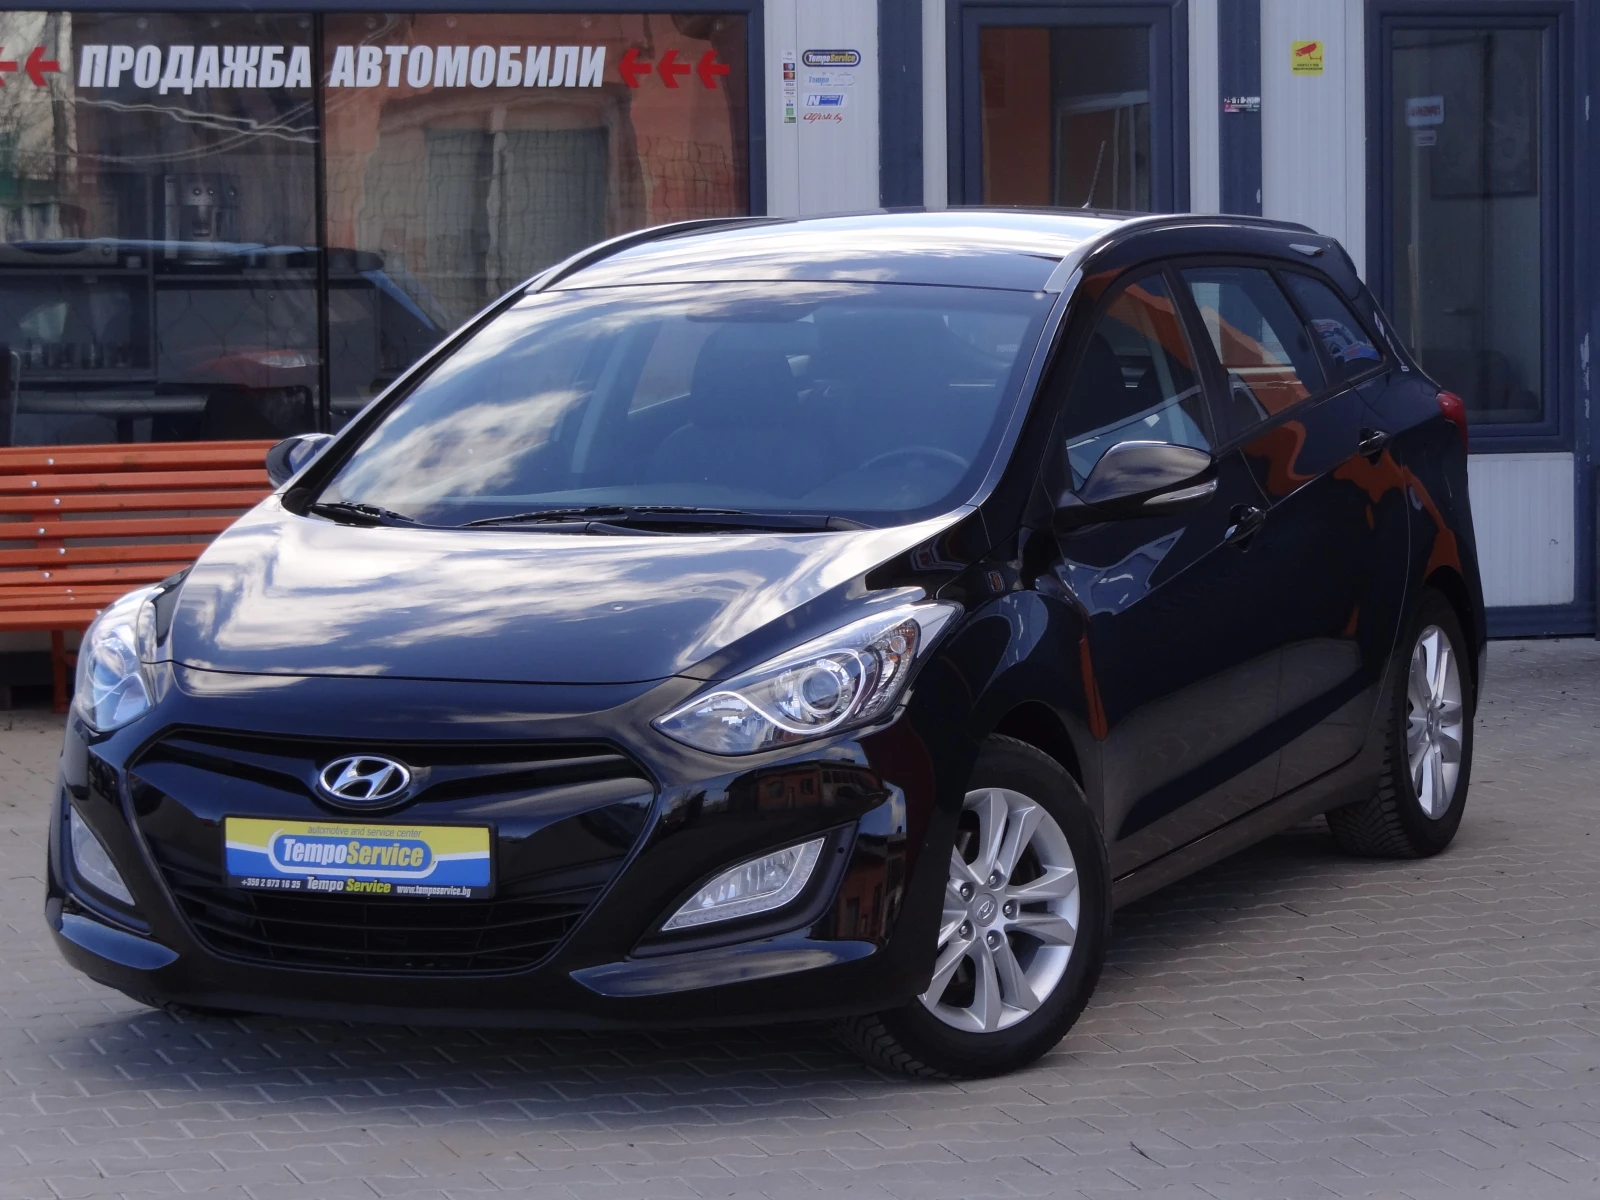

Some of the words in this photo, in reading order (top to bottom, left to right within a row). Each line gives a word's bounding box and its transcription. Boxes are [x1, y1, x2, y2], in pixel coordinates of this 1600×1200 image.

[78, 44, 312, 95] ПРОДАЖБА
[328, 44, 607, 89] АВТОМОБИЛИ
[808, 54, 856, 65] TempoService
[308, 825, 349, 836] automotive
[350, 827, 365, 836] and
[367, 828, 394, 837] service
[396, 829, 422, 838] center
[283, 838, 425, 867] TempoService
[241, 877, 260, 887] +359
[260, 878, 266, 887] 2
[307, 876, 344, 892] Tempo
[346, 878, 392, 893] Service
[396, 885, 472, 898] www.temposervice.bg
